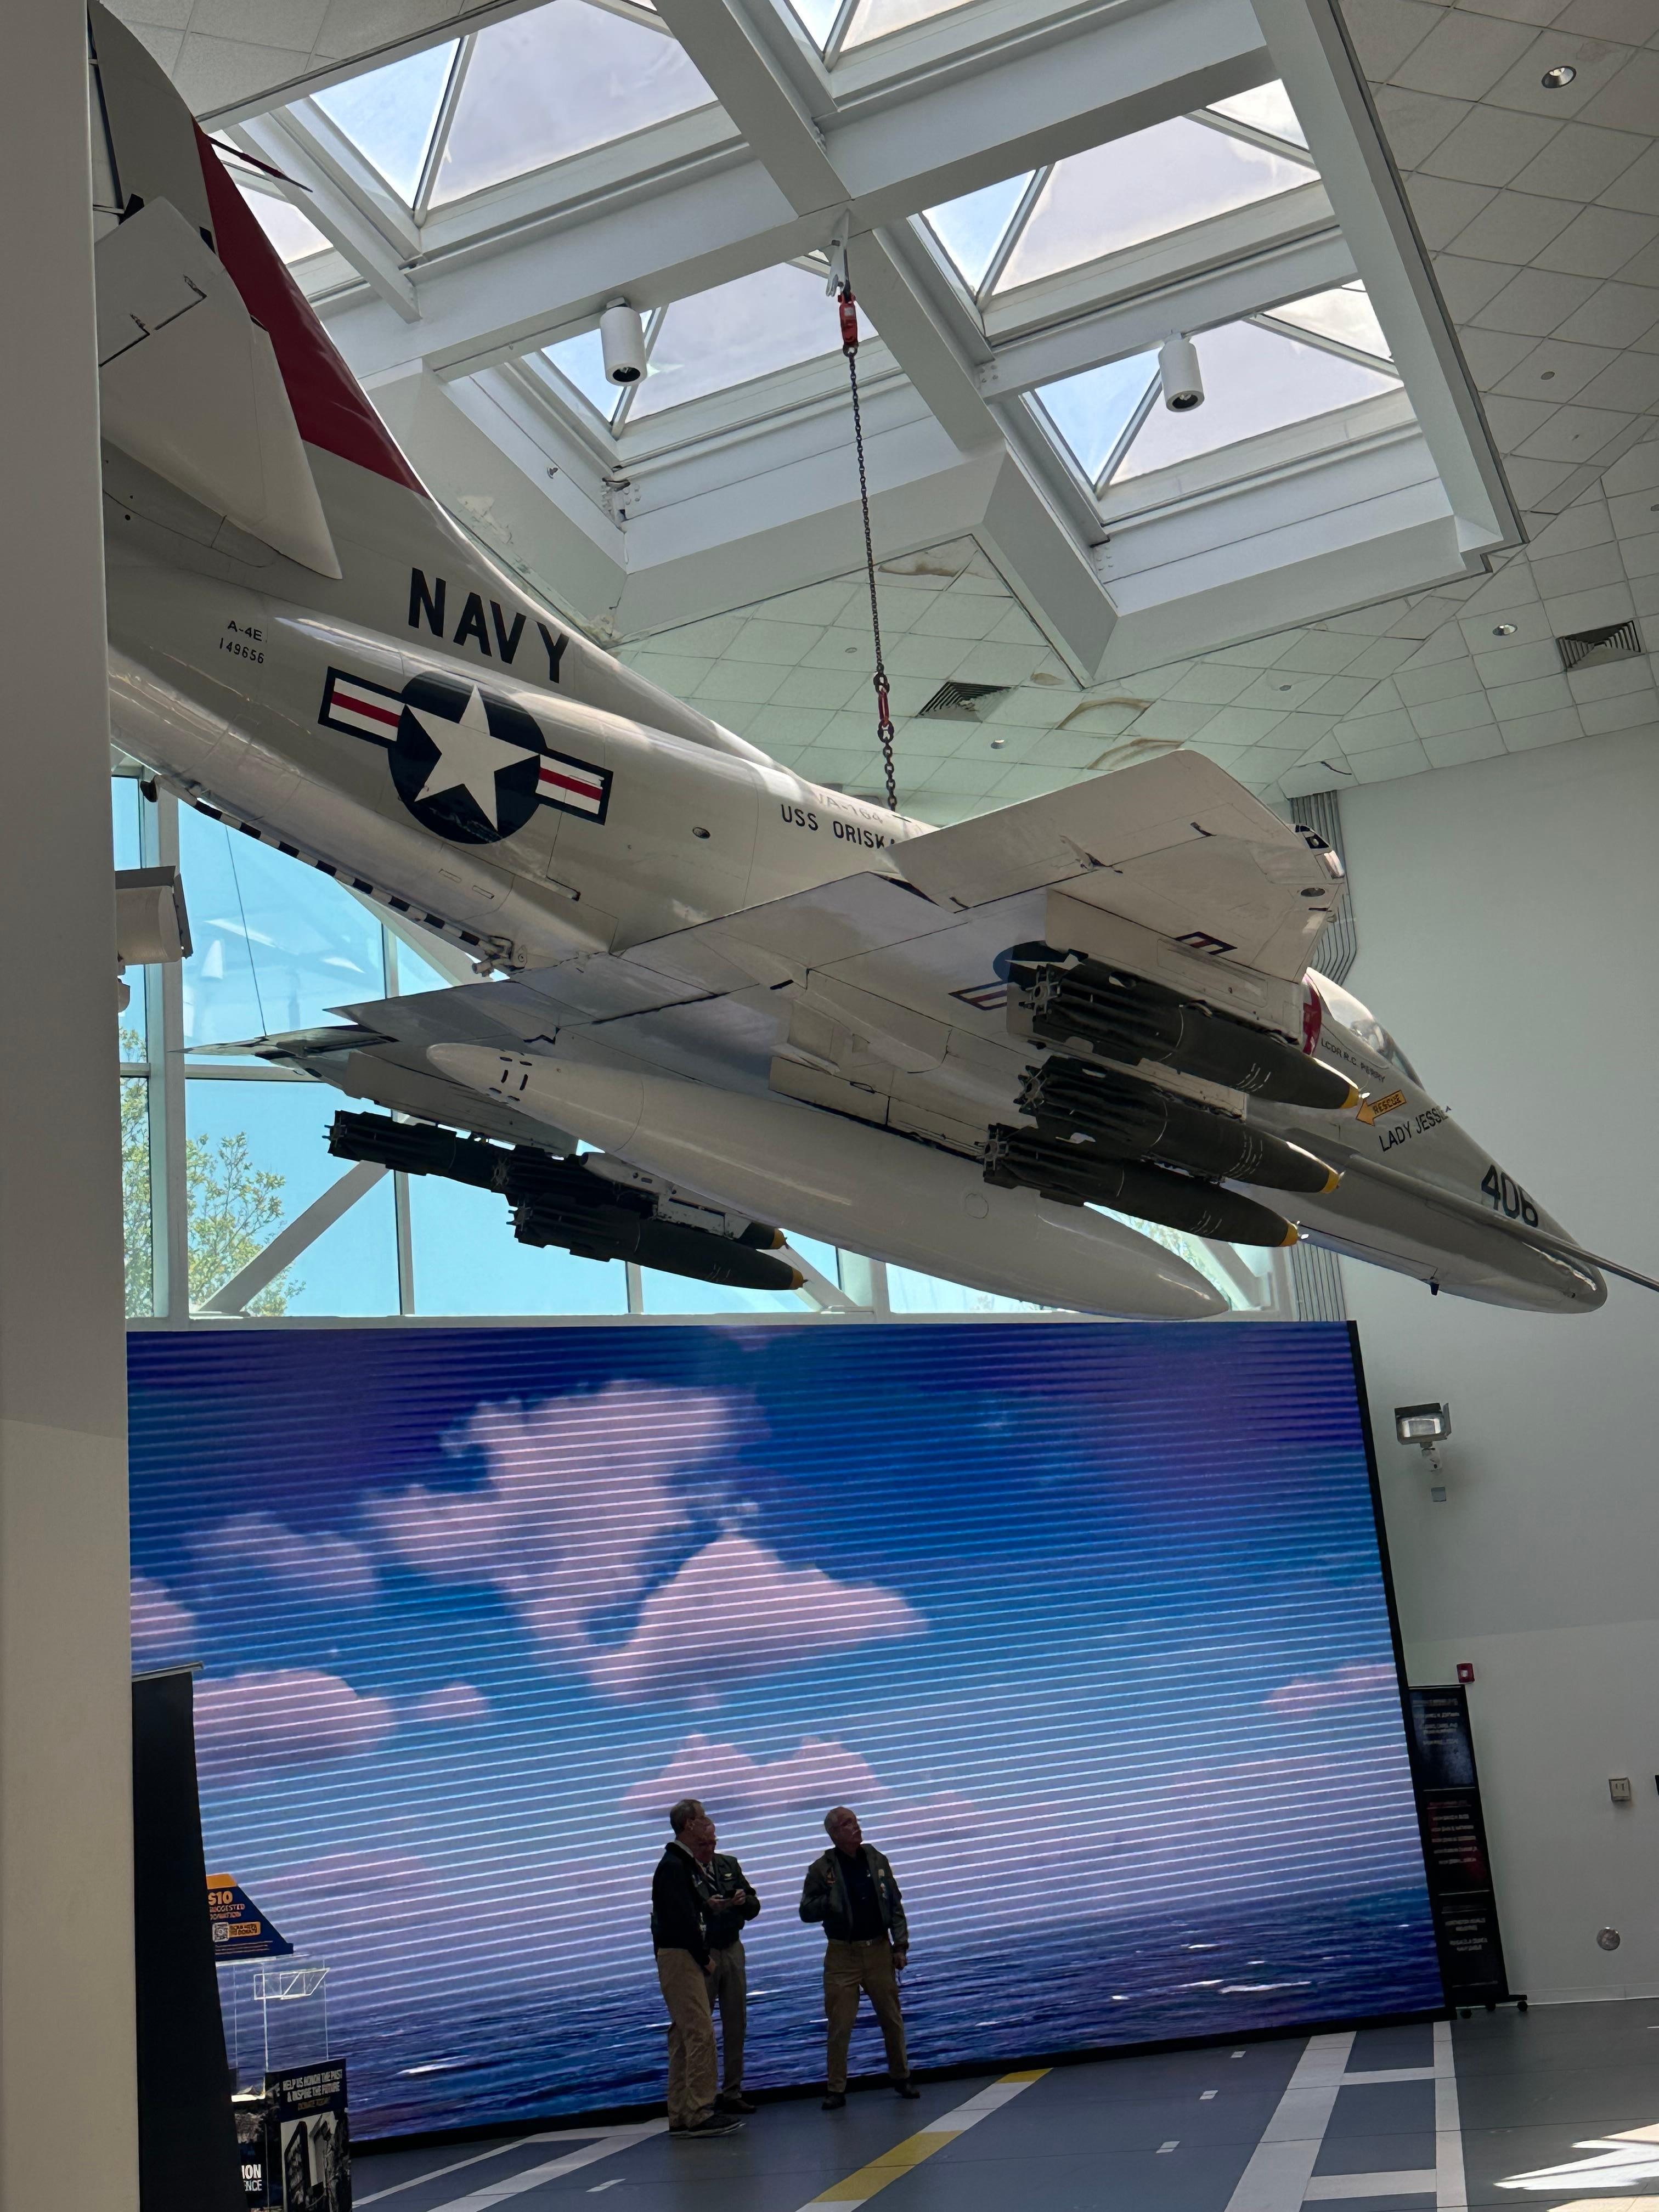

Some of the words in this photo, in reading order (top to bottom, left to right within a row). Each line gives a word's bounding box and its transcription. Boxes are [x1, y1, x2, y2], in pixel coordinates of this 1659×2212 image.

[227, 620, 262, 642] A-4E
[408, 567, 569, 684] NAVY
[219, 637, 264, 664] 149656
[781, 804, 819, 831] USS
[1321, 1037, 1342, 1058] LCDR
[1373, 1094, 1402, 1115] RESCUE
[1379, 1121, 1412, 1153] LADY
[1481, 1164, 1539, 1228] 406
